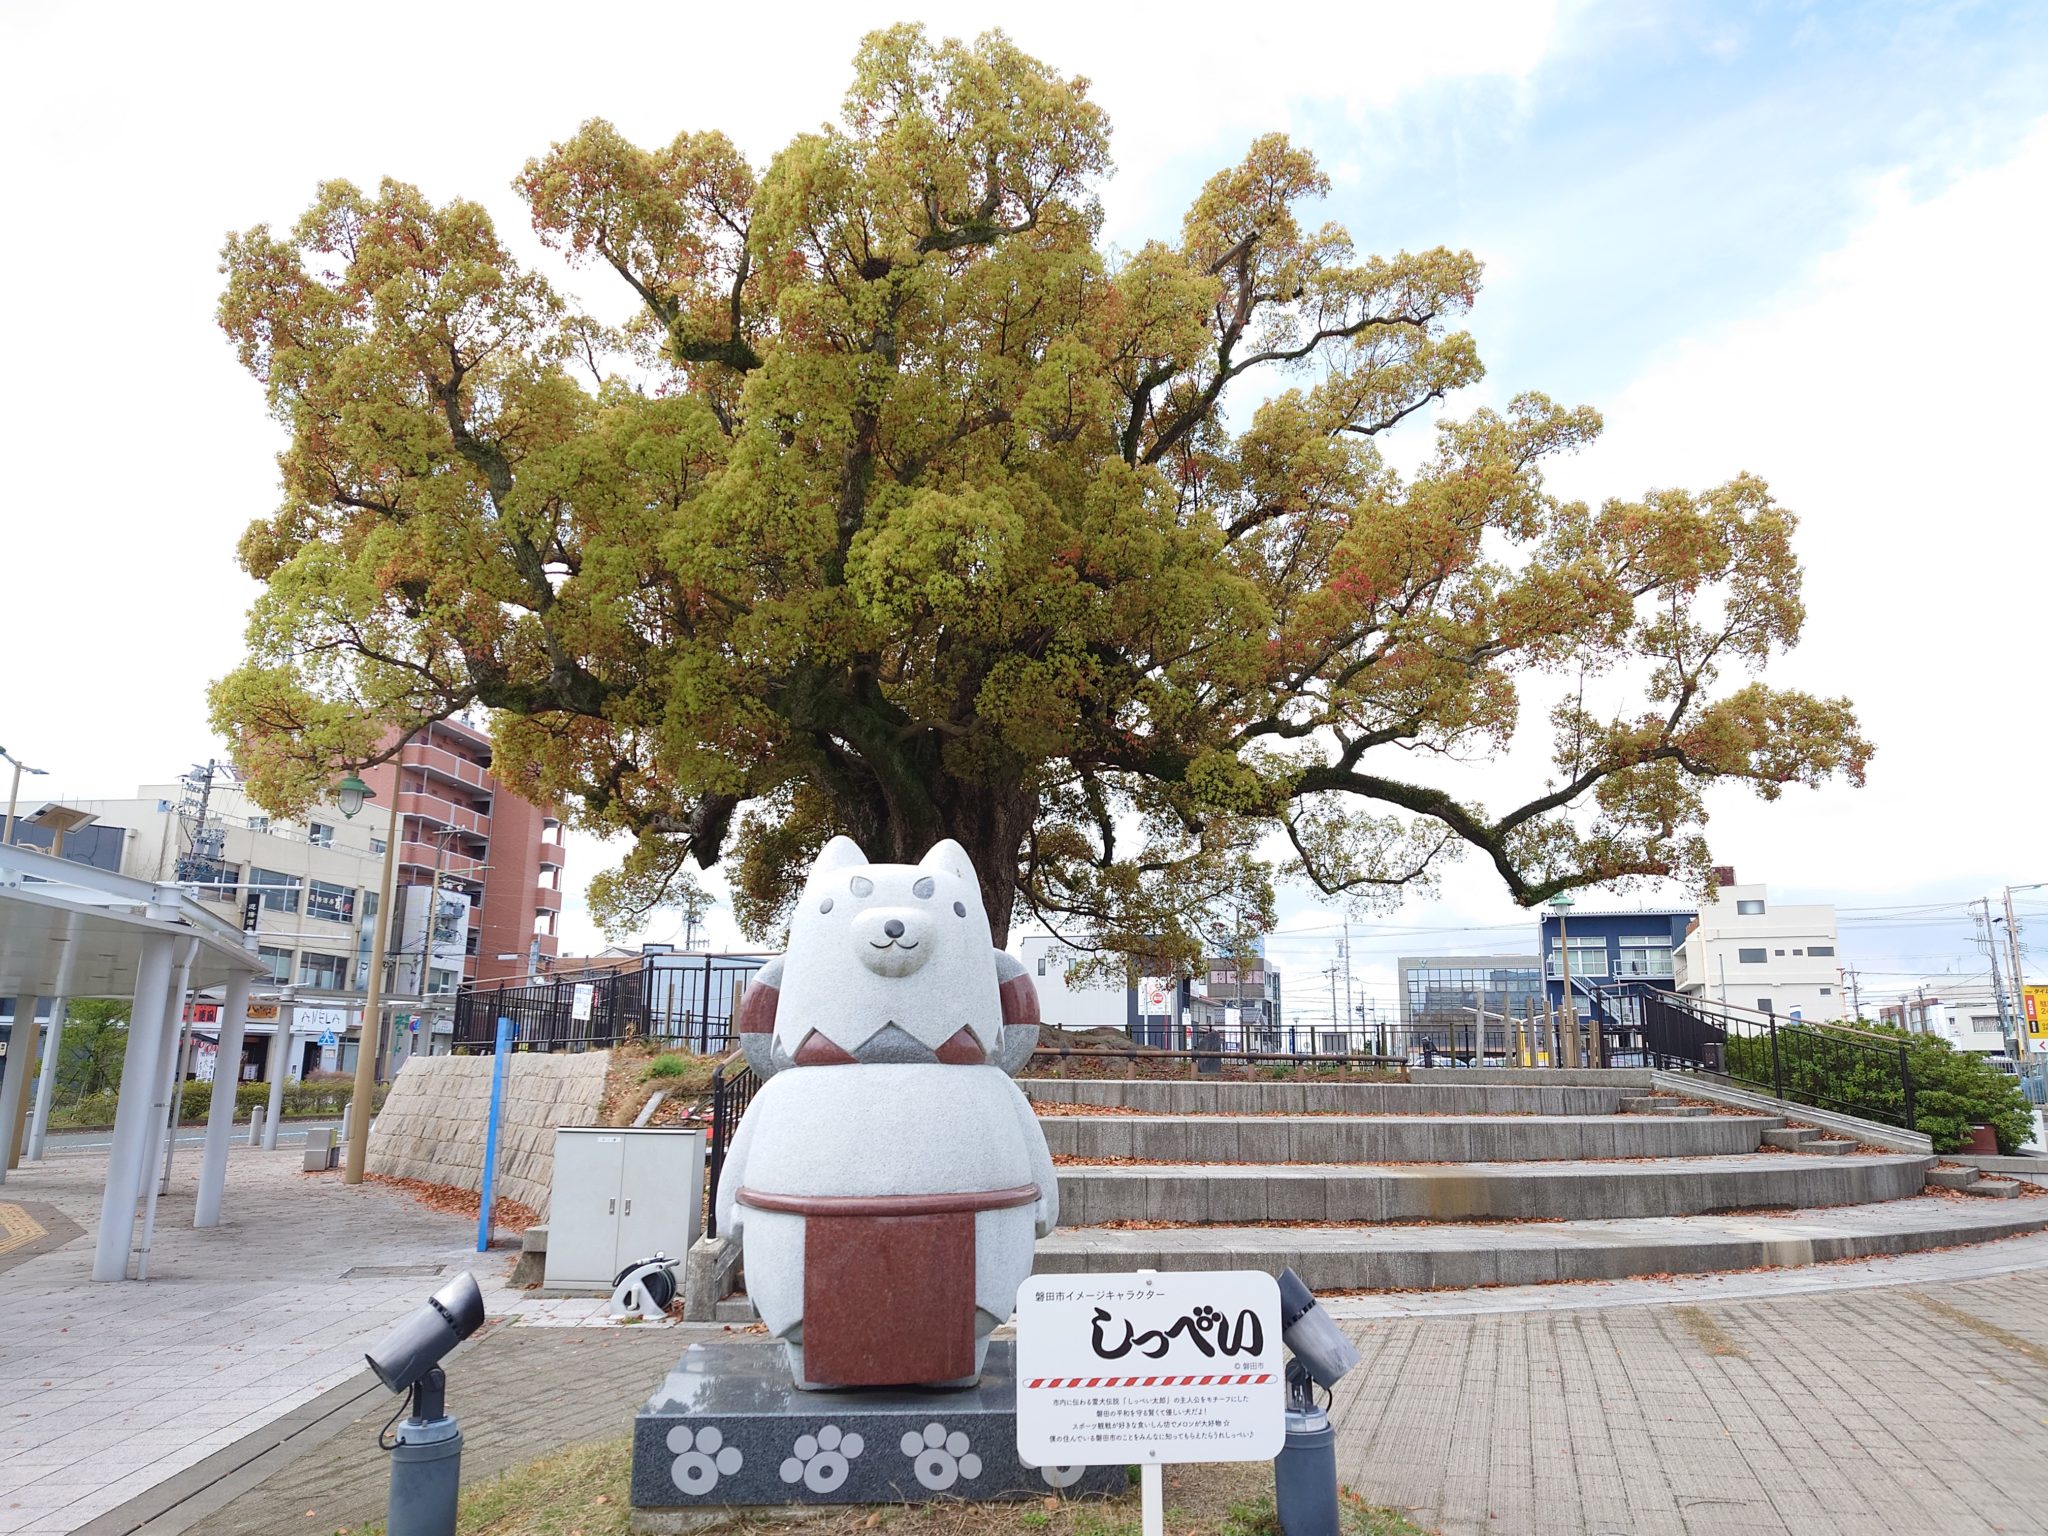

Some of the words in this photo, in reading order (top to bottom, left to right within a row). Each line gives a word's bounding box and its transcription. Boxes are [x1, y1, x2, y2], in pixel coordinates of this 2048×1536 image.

[1035, 1290, 1165, 1302] 磐田市イメージキャラクター
